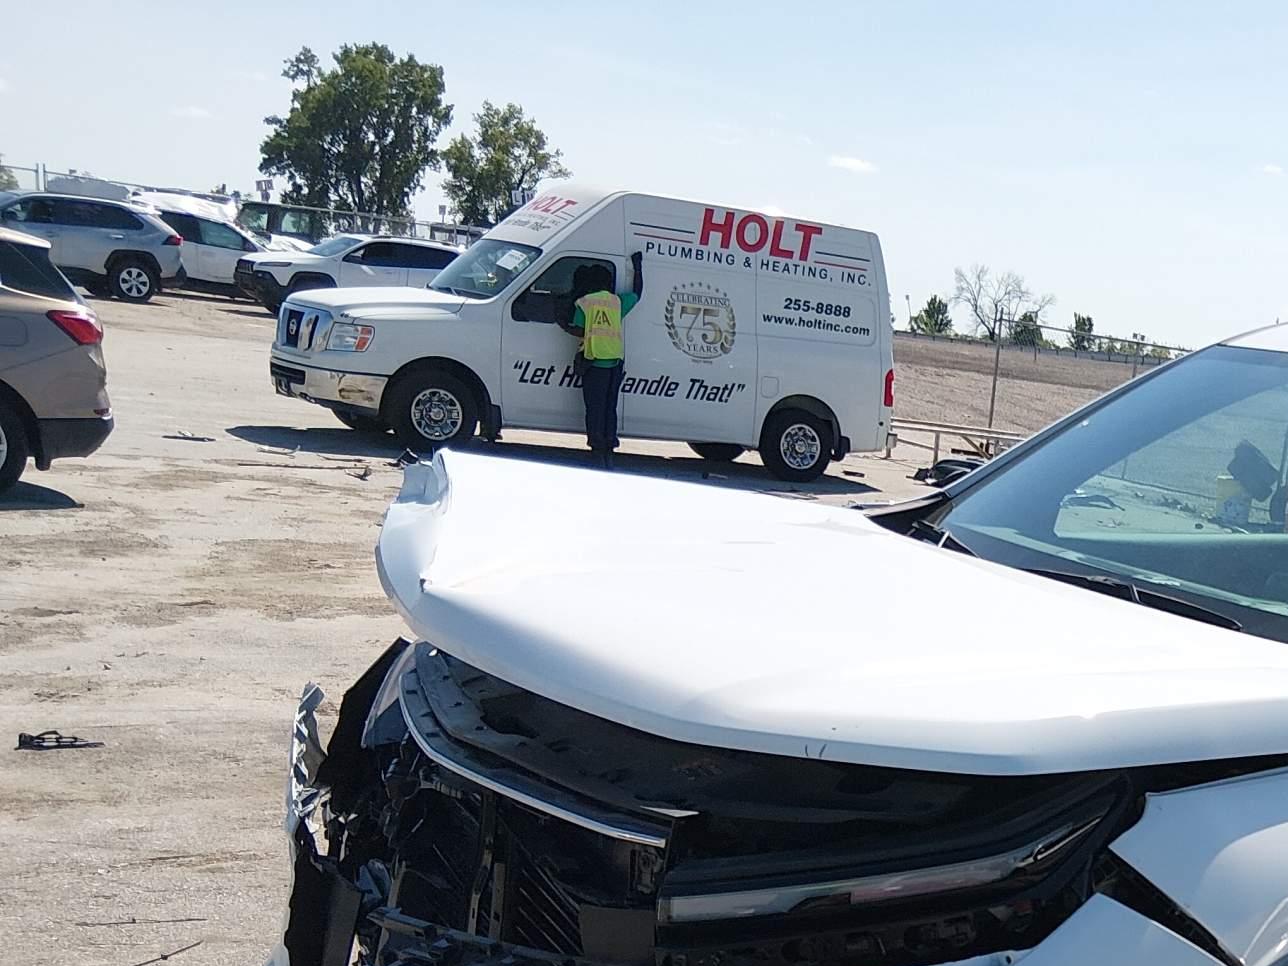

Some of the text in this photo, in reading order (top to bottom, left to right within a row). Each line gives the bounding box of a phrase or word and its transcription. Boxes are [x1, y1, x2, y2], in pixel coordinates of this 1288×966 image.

[699, 207, 823, 262] HOLT
[645, 241, 872, 287] PLUMBING & HEATING, INC.
[783, 297, 852, 318] 255-8888
[679, 305, 724, 345] 75
[762, 313, 871, 337] www.holtinc.com
[686, 342, 720, 354] YEARS
[559, 365, 584, 389] Ho
[620, 371, 680, 398] andle
